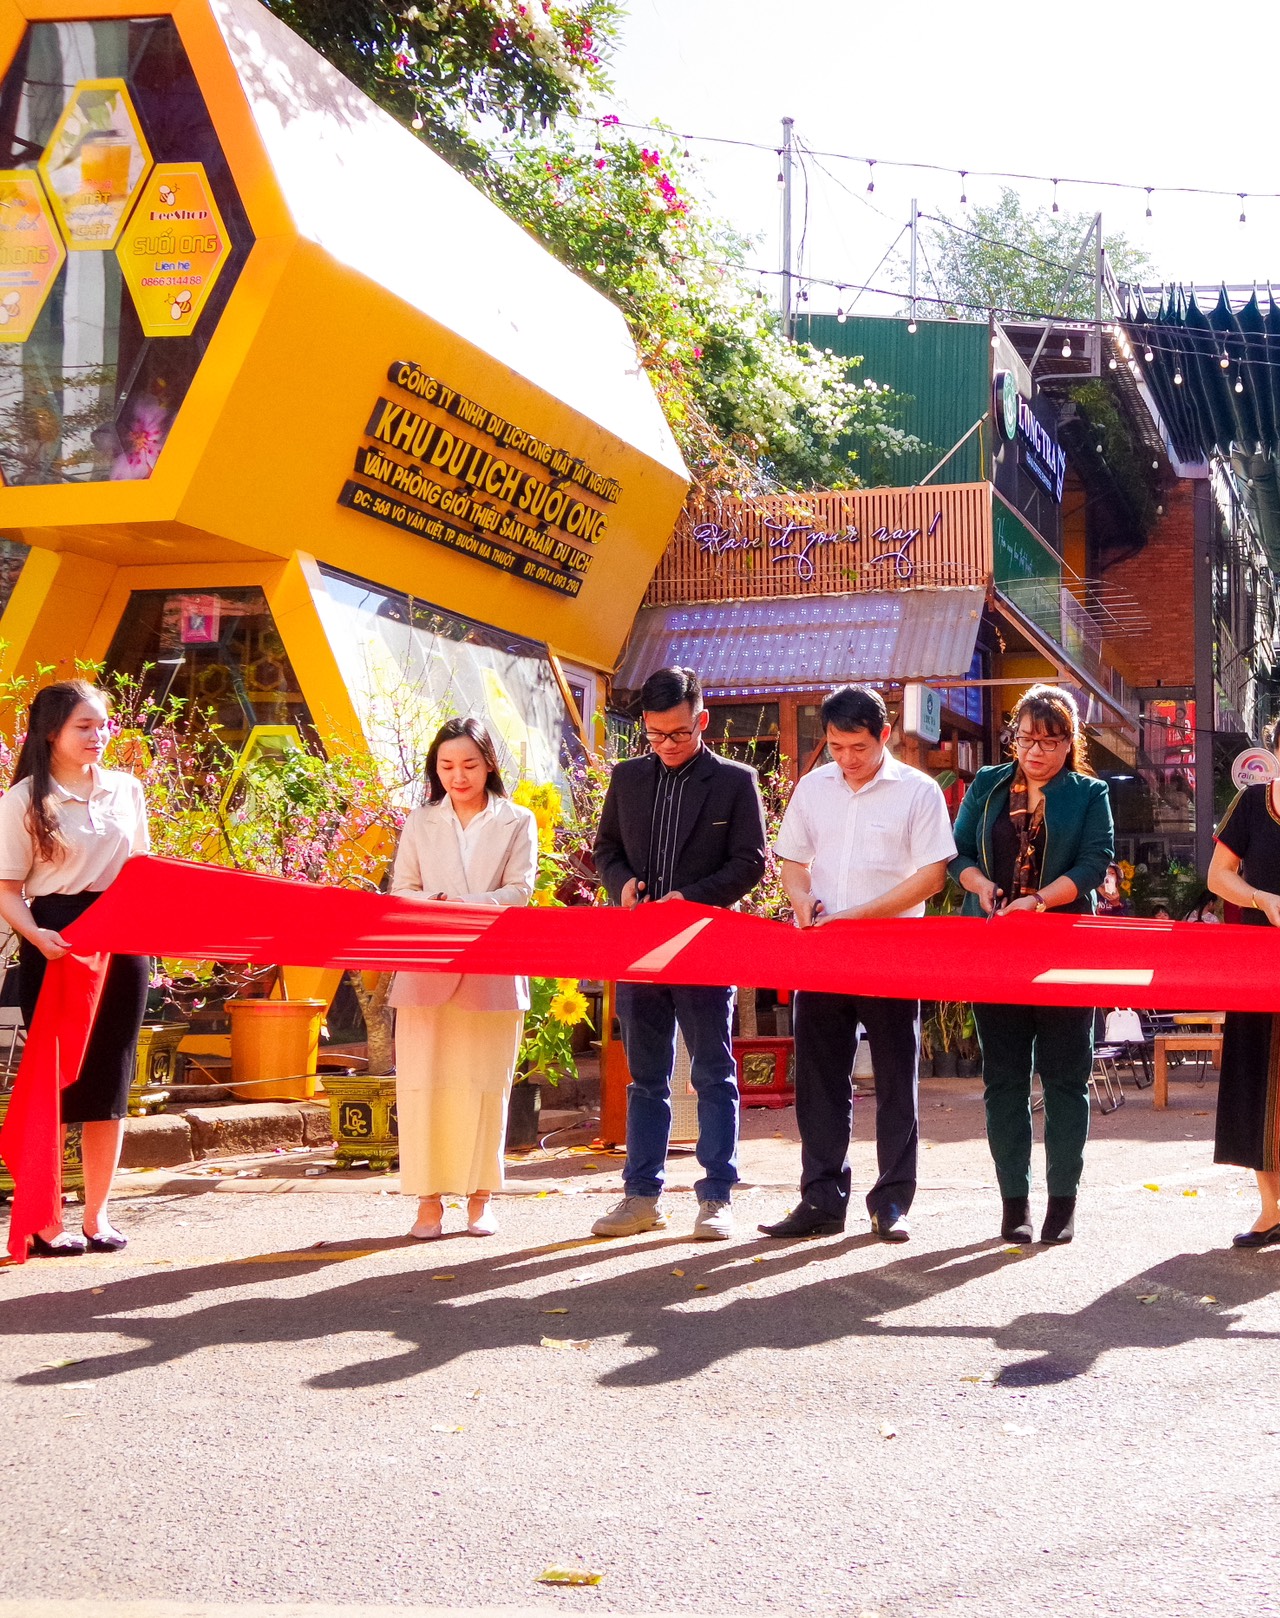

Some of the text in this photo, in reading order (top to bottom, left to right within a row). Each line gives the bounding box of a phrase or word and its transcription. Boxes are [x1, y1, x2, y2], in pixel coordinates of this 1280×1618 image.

[133, 228, 218, 255] SUỐI ONG
[398, 365, 438, 400] CÔNG
[438, 386, 457, 410] TY
[456, 396, 488, 428] TNHH
[486, 414, 506, 438] DU
[503, 425, 530, 452] LỊCH
[527, 439, 553, 464] ONG
[550, 451, 575, 479] MẬT
[587, 474, 623, 503] NGUYÊN
[1018, 393, 1041, 454] LONG
[363, 450, 393, 482] VĂN
[390, 465, 442, 505] PHÒNG
[440, 490, 472, 519] GIỚI
[468, 501, 501, 534] THIỆU
[499, 513, 526, 543] SẢN
[552, 541, 572, 563] DU
[567, 552, 594, 574] LỊCH
[374, 400, 609, 544] KHU DU LỊCH SUỐI ONG
[353, 489, 373, 509] ĐC:
[372, 497, 392, 516] 568
[391, 505, 407, 522] VÕ
[406, 511, 427, 531] VĂN
[444, 527, 457, 544] TP.
[455, 534, 480, 554] BUÔN
[478, 542, 493, 559] MA
[490, 544, 517, 570] THUỘT
[523, 561, 536, 577] ĐT:
[535, 566, 554, 585] 0914
[552, 572, 568, 589] 093
[565, 579, 580, 594] 298
[763, 516, 814, 549] it
[771, 524, 858, 582] your
